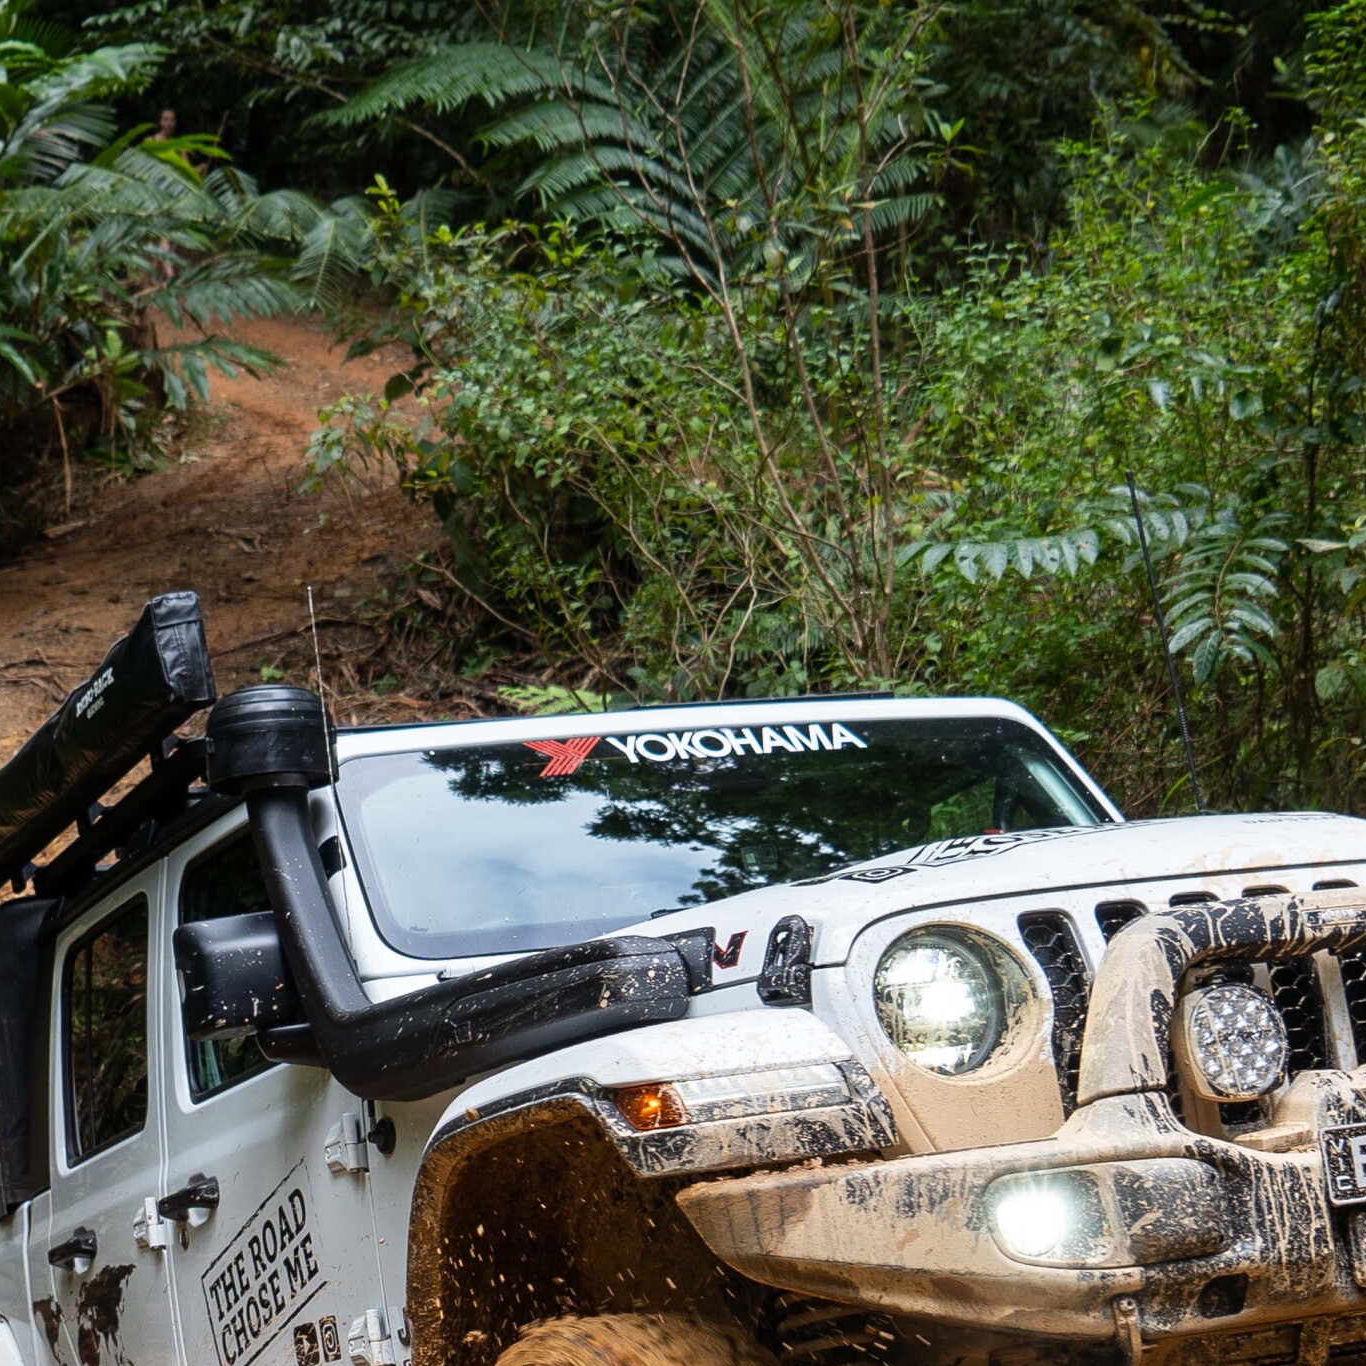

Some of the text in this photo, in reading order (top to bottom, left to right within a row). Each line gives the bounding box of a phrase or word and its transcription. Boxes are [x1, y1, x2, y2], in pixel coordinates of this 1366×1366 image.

[606, 723, 867, 763] YOKOHAMA
[1329, 1139, 1352, 1190] VIC
[210, 1188, 307, 1321] THE ROAD
[221, 1233, 319, 1366] CHOSE ME
